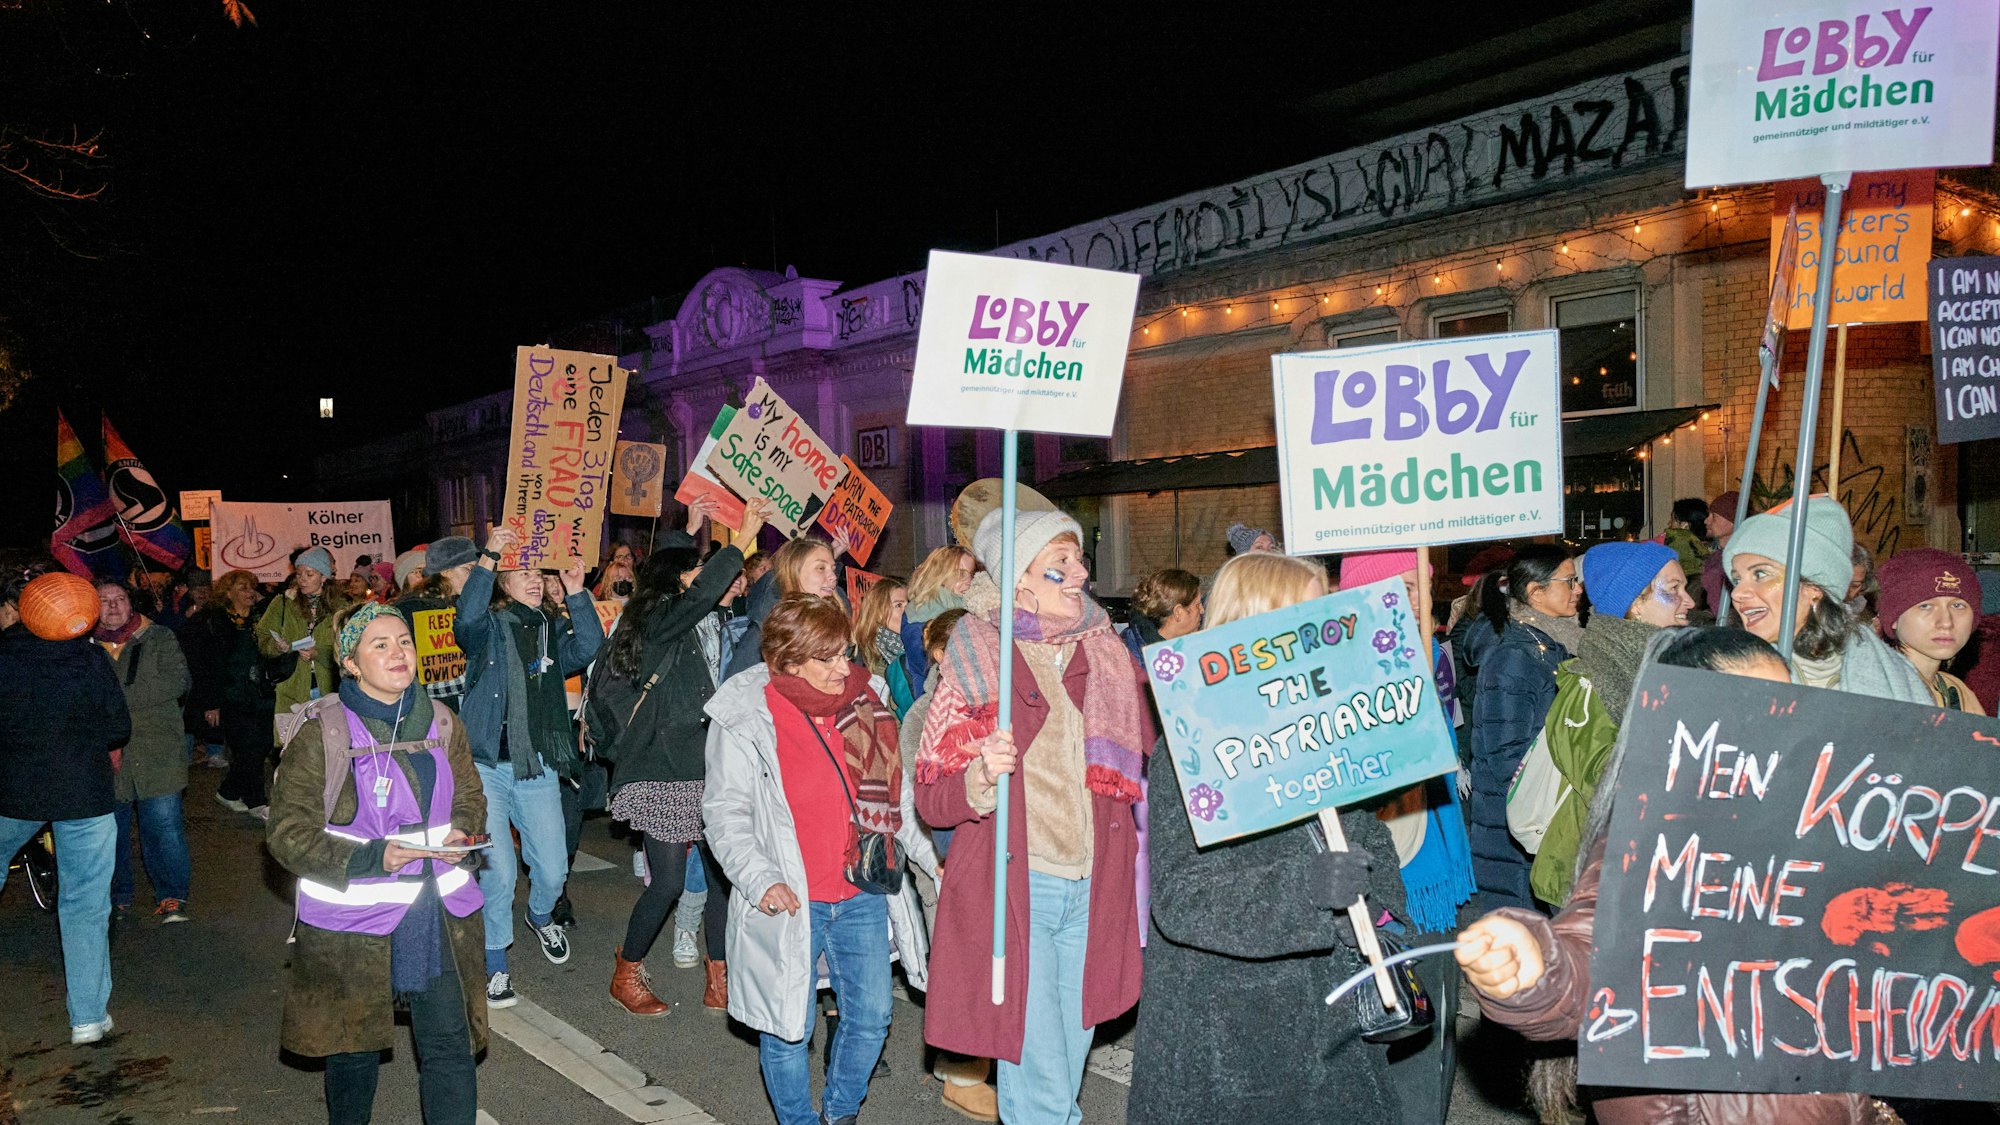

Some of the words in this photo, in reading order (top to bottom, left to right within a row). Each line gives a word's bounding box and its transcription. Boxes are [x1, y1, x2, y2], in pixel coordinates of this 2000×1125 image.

[1912, 51, 1935, 63] für
[1755, 74, 1934, 122] Mädchen
[1753, 125, 1829, 143] gemeinnütziger
[1832, 121, 1851, 132] und
[1853, 117, 1908, 130] mildtätiger
[1911, 115, 1931, 126] e.V.
[1867, 181, 1909, 209] my
[1800, 235, 1901, 269] aound
[1834, 273, 1905, 303] world
[1938, 268, 1945, 296] I
[1952, 268, 1980, 295] AM
[1986, 270, 2000, 295] N
[1072, 338, 1087, 348] für
[1981, 326, 2000, 346] NO
[963, 347, 1083, 381] Mädchen
[1942, 357, 1947, 380] I
[1952, 356, 1975, 377] AM
[564, 363, 577, 411] eine
[587, 364, 612, 442] Jeden
[960, 385, 1014, 395] gemeinnütziger
[1017, 388, 1030, 396] und
[1030, 389, 1065, 398] mildtätiger
[1066, 390, 1078, 398] e.V.
[1945, 388, 1954, 421] I
[1957, 384, 1998, 419] CAN
[521, 353, 554, 469] Deutschland
[1510, 411, 1538, 428] für
[754, 428, 770, 451] is
[781, 417, 838, 490] home
[861, 433, 886, 462] DB
[545, 420, 585, 508] FRAU
[516, 474, 534, 515] ihrem
[532, 473, 543, 500] von
[1312, 453, 1542, 511] Mädchen
[308, 510, 364, 524] Kölner
[545, 513, 561, 532] in
[842, 497, 881, 540] PATRIARCHY
[868, 497, 882, 517] THE
[310, 531, 382, 549] Beginen
[568, 517, 586, 557] wird
[1315, 522, 1416, 541] gemeinnütziger
[1419, 518, 1444, 531] und
[1448, 512, 1516, 528] mildtätiger
[1519, 509, 1542, 522] e.V.
[421, 655, 436, 667] LET
[436, 652, 458, 665] THEM
[1199, 613, 1358, 686] DESTROY
[1258, 666, 1333, 707] THE
[1213, 676, 1424, 780] PATRIARCHY
[1265, 748, 1393, 808] together
[1643, 833, 1824, 926] MEINE
